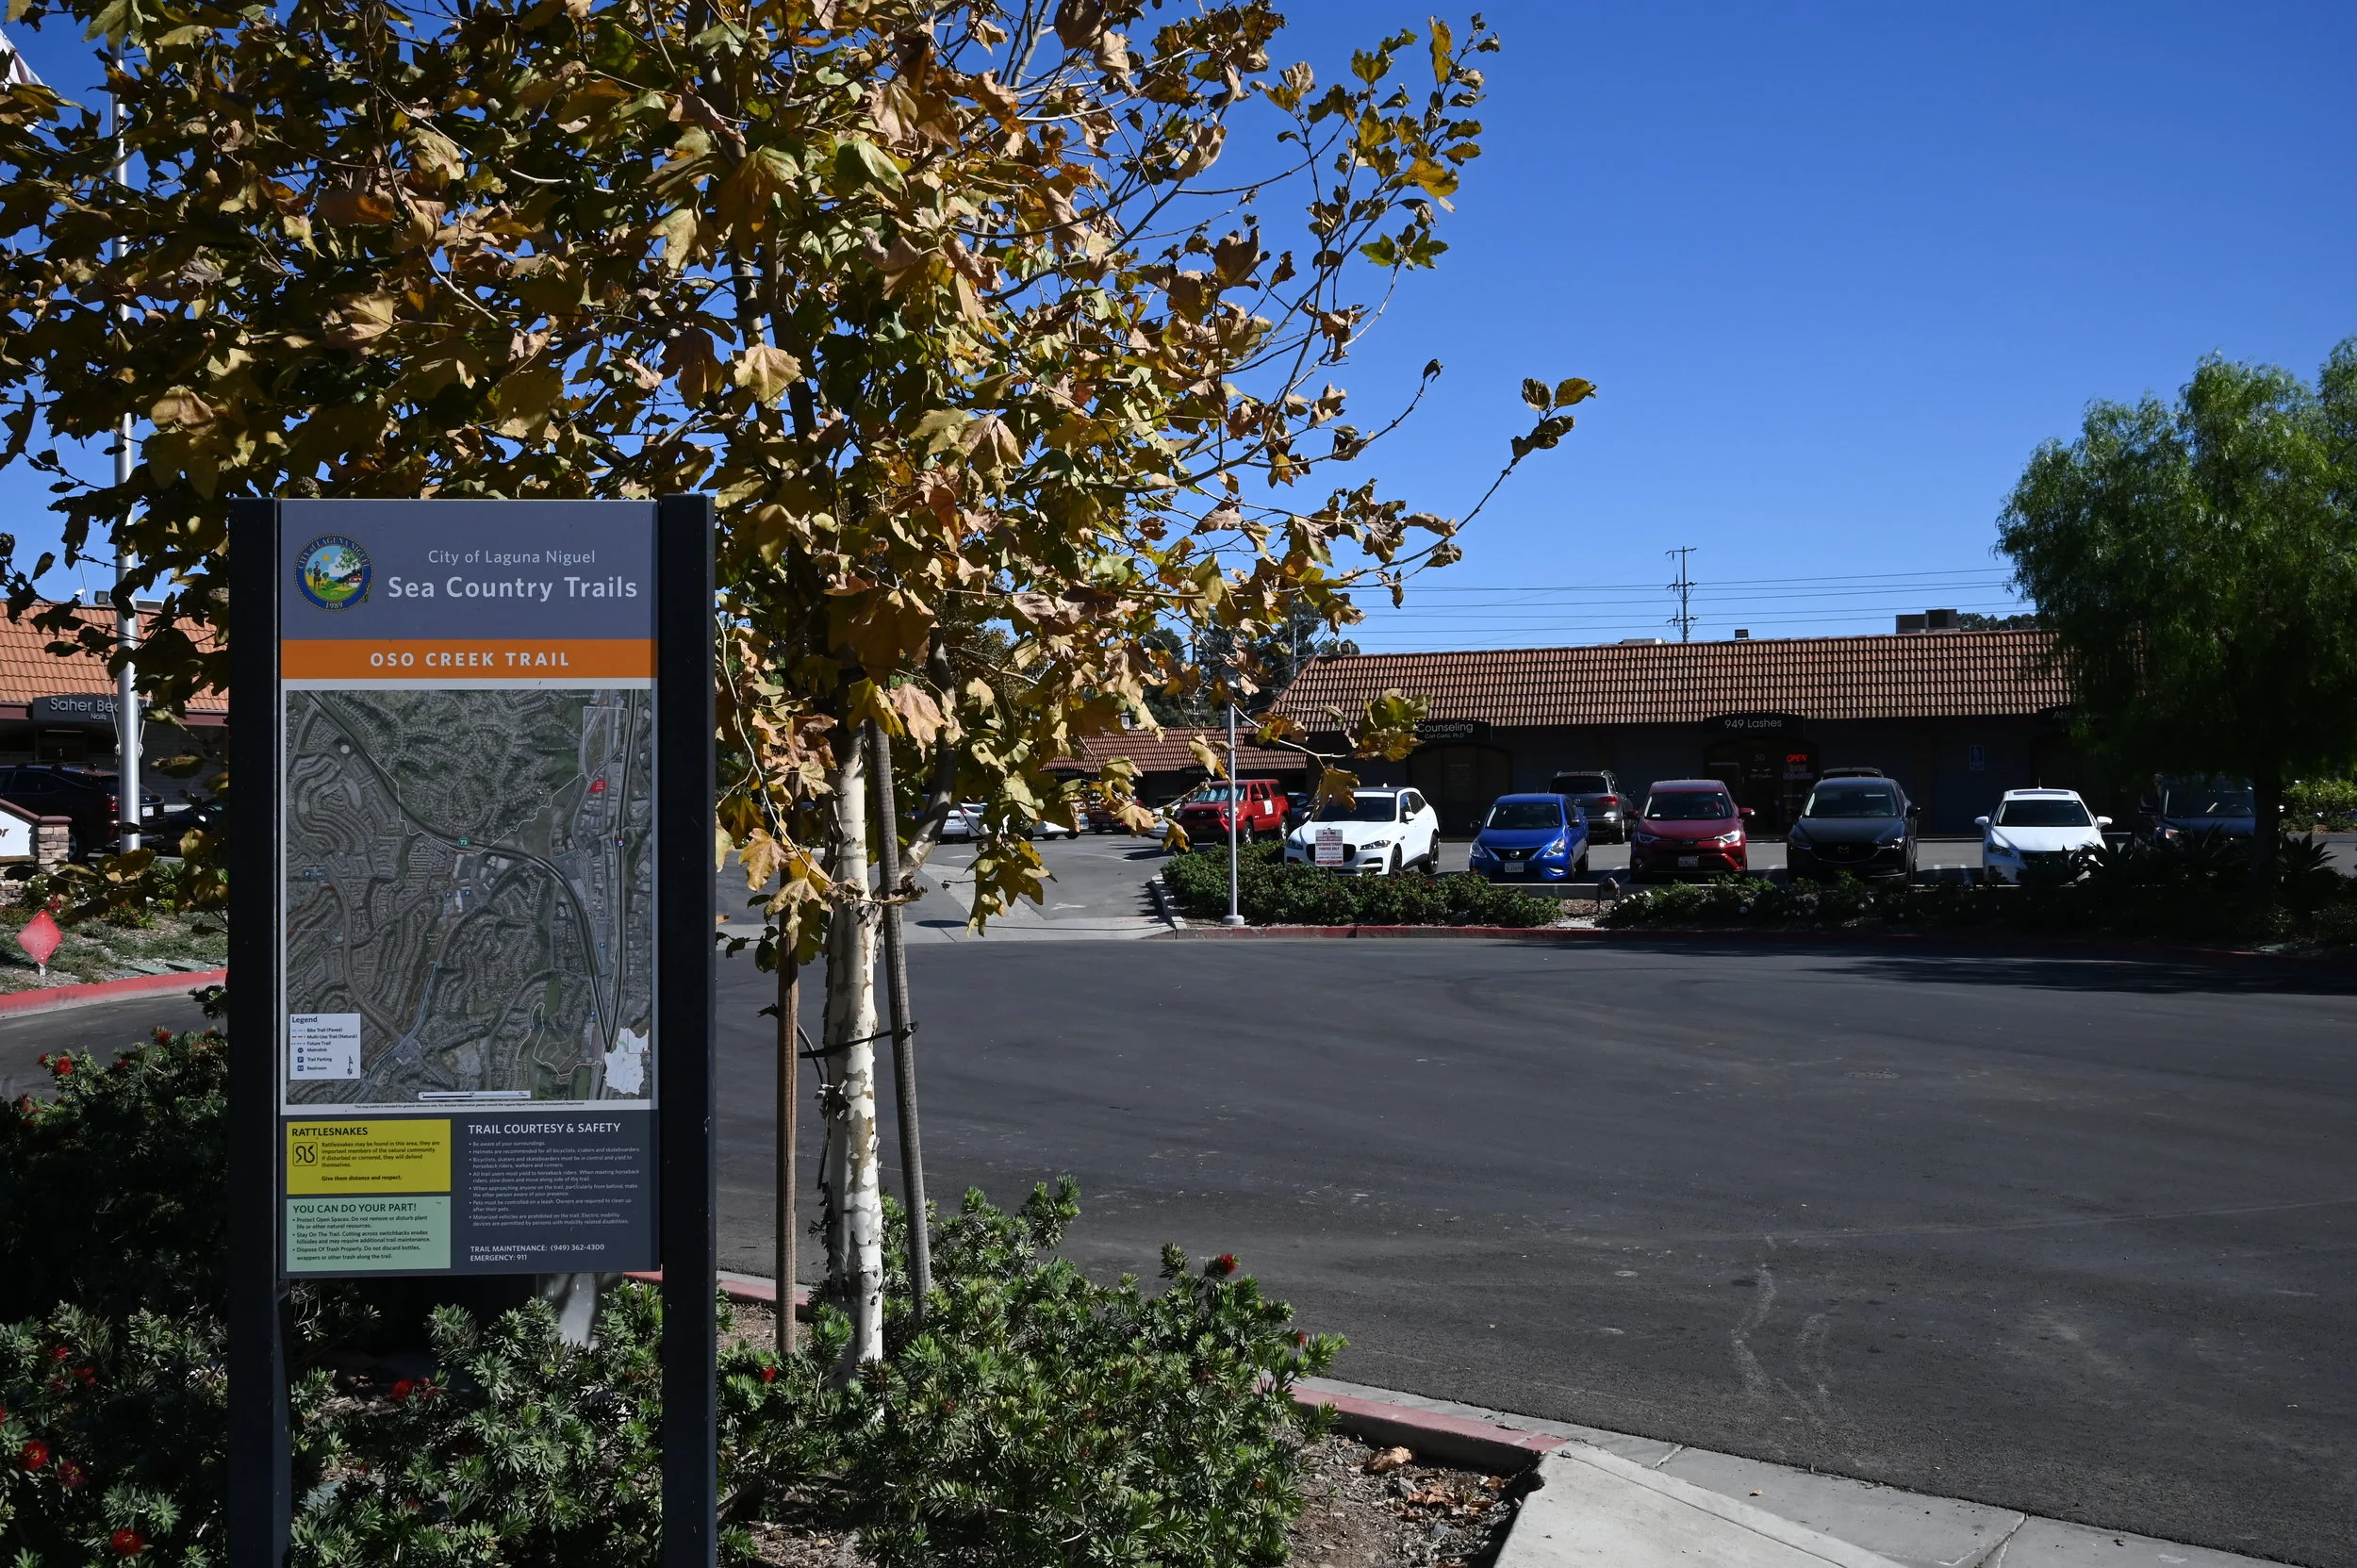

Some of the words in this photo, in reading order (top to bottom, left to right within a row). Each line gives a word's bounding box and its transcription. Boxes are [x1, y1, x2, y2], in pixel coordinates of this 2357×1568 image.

[429, 551, 458, 566] City
[465, 551, 480, 563] of
[486, 551, 540, 566] Laguna
[546, 551, 596, 566] Niguel
[388, 576, 435, 598] Sea
[446, 576, 553, 602] Country
[564, 576, 637, 598] Trails
[371, 652, 415, 667] OSO
[425, 652, 495, 667] CREEK
[504, 652, 569, 667] TRAIL
[50, 698, 92, 712] Saher
[1417, 722, 1474, 734] Counseling
[1724, 719, 1744, 729] 949
[1747, 718, 1782, 728] Lashes
[1786, 754, 1807, 763] OPEN
[292, 1128, 368, 1136] RATTLESNAKES
[469, 1125, 501, 1134] TRAIL
[503, 1124, 564, 1133] COURTESY
[577, 1123, 620, 1132] SAFETY
[316, 1204, 338, 1213] CAN
[340, 1204, 356, 1213] DO
[387, 1203, 417, 1212] PART!
